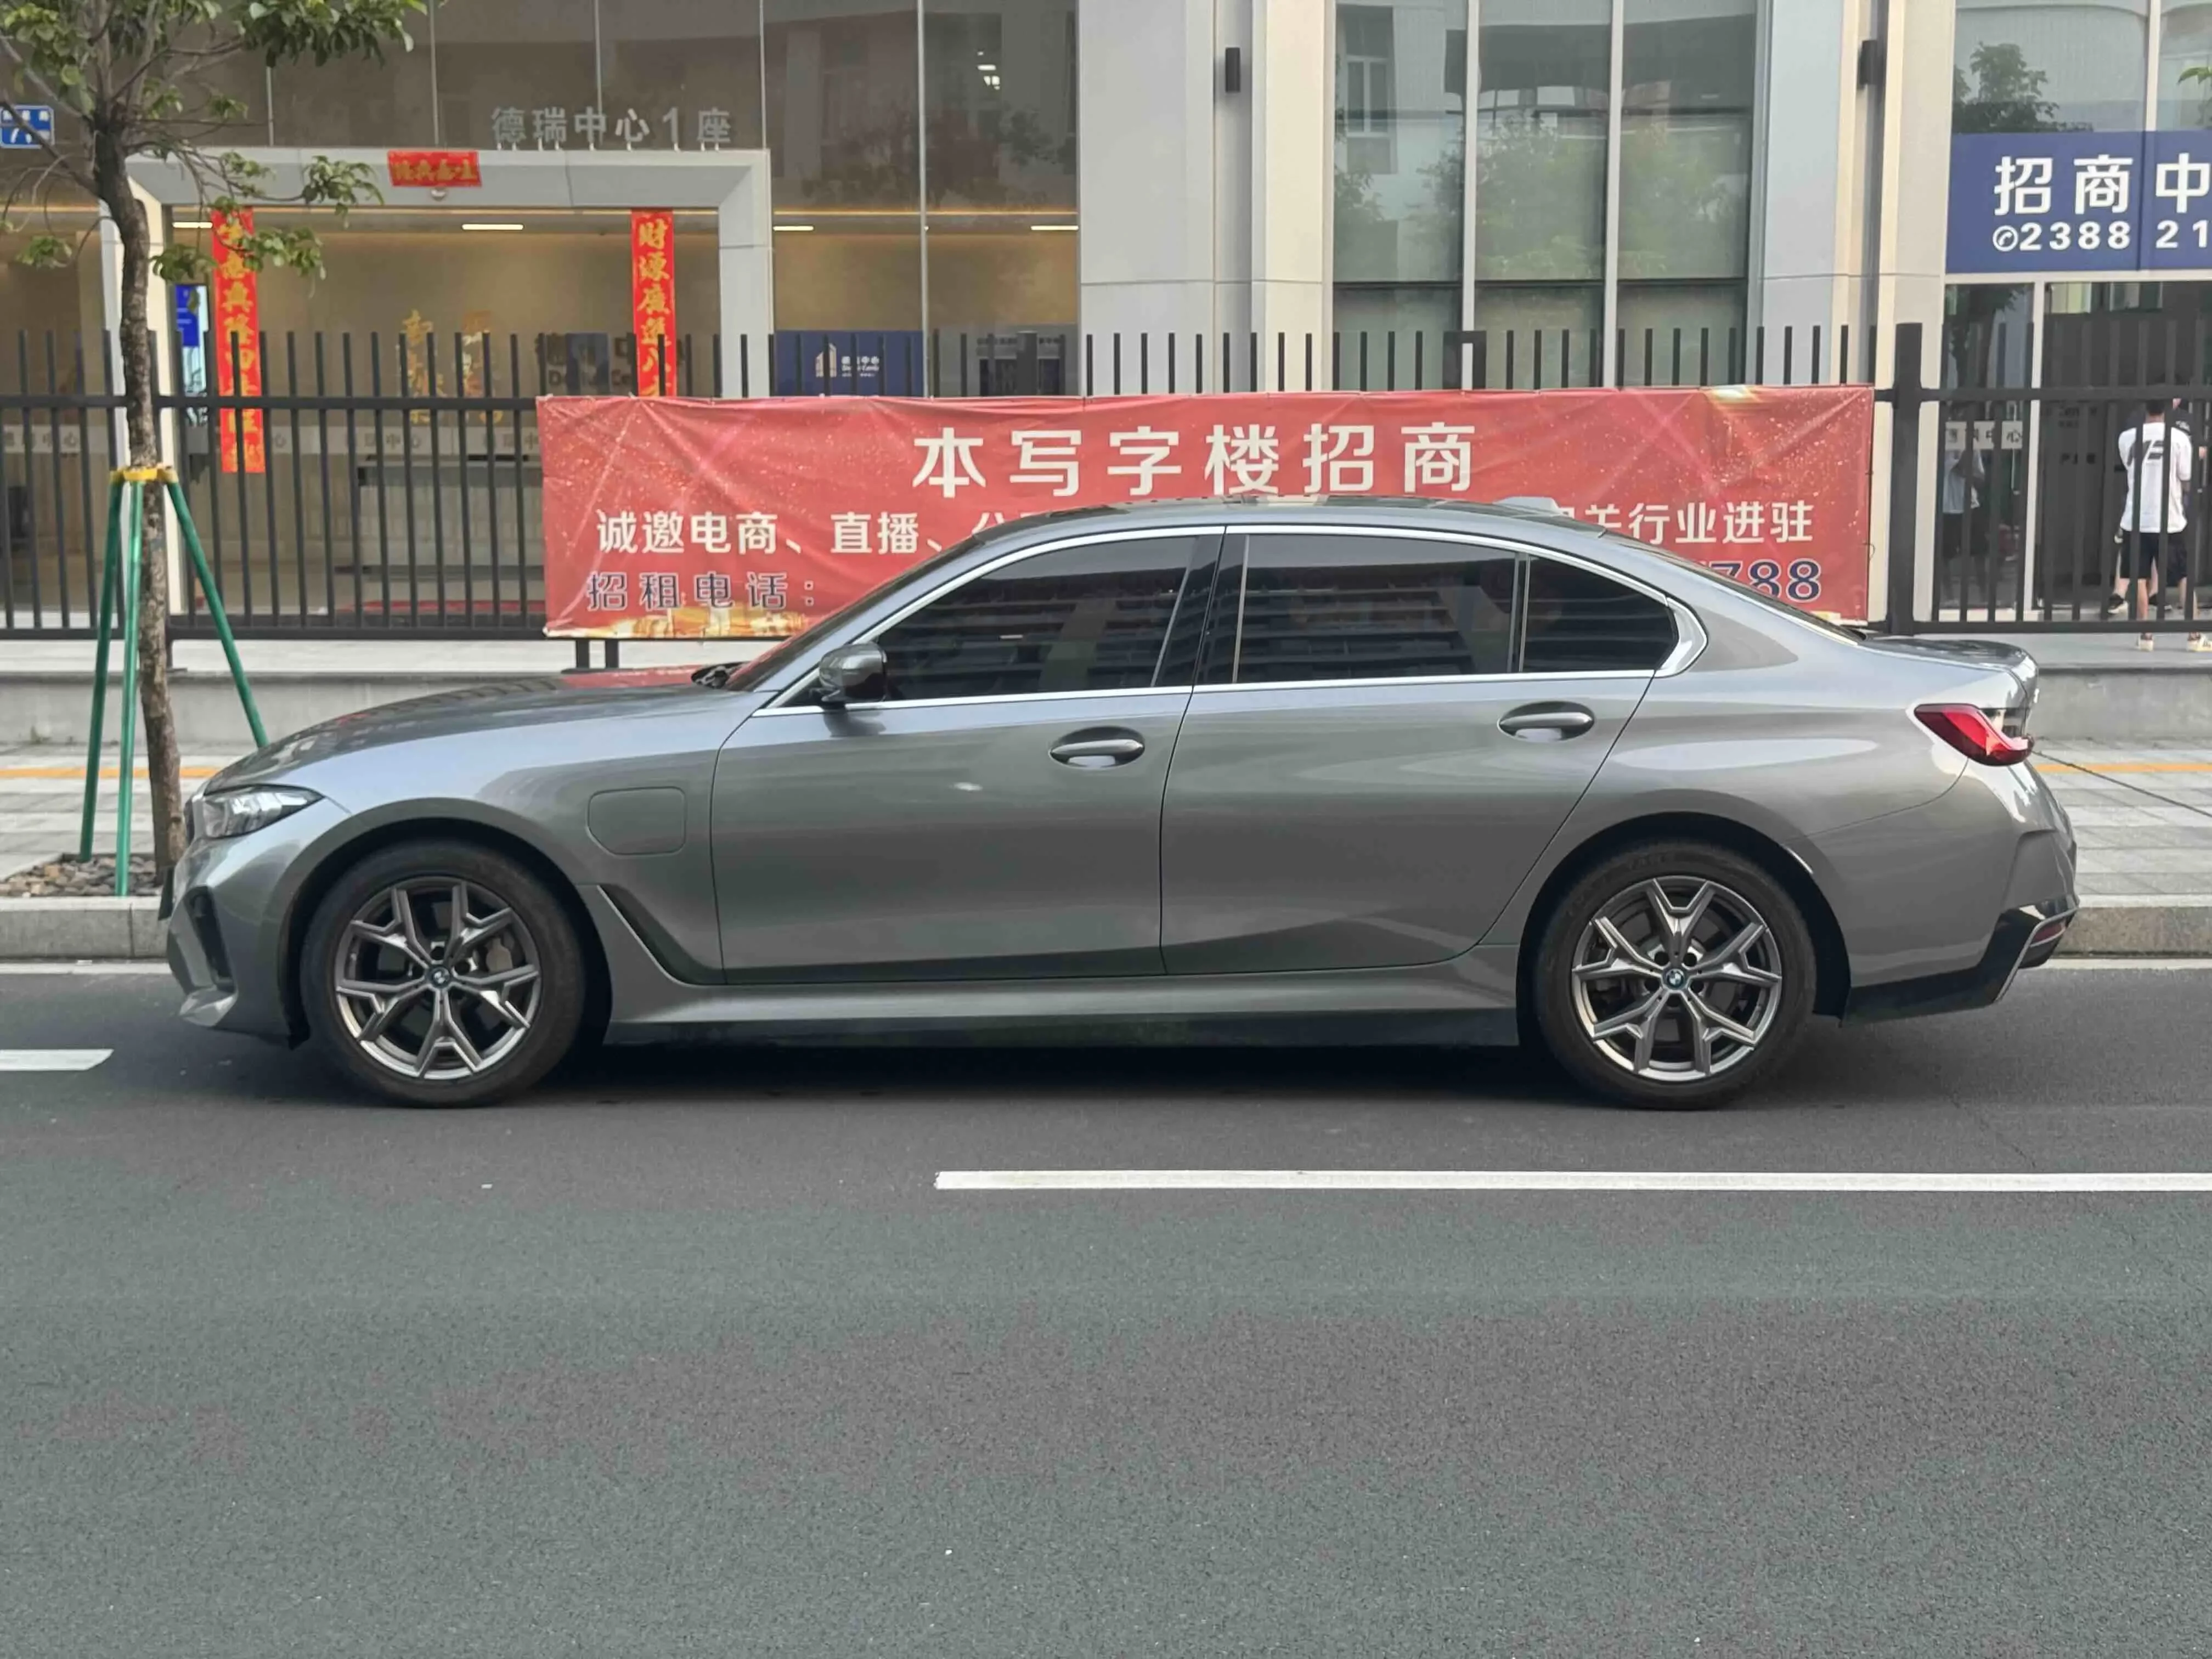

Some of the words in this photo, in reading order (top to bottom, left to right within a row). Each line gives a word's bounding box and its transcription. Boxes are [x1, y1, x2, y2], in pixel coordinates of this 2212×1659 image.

[492, 106, 731, 144] 德瑞中心1座
[1994, 153, 2211, 216] 招商中
[2019, 221, 2131, 251] 2388
[2155, 220, 2208, 249] 21
[912, 422, 1476, 498] 本写字楼招商
